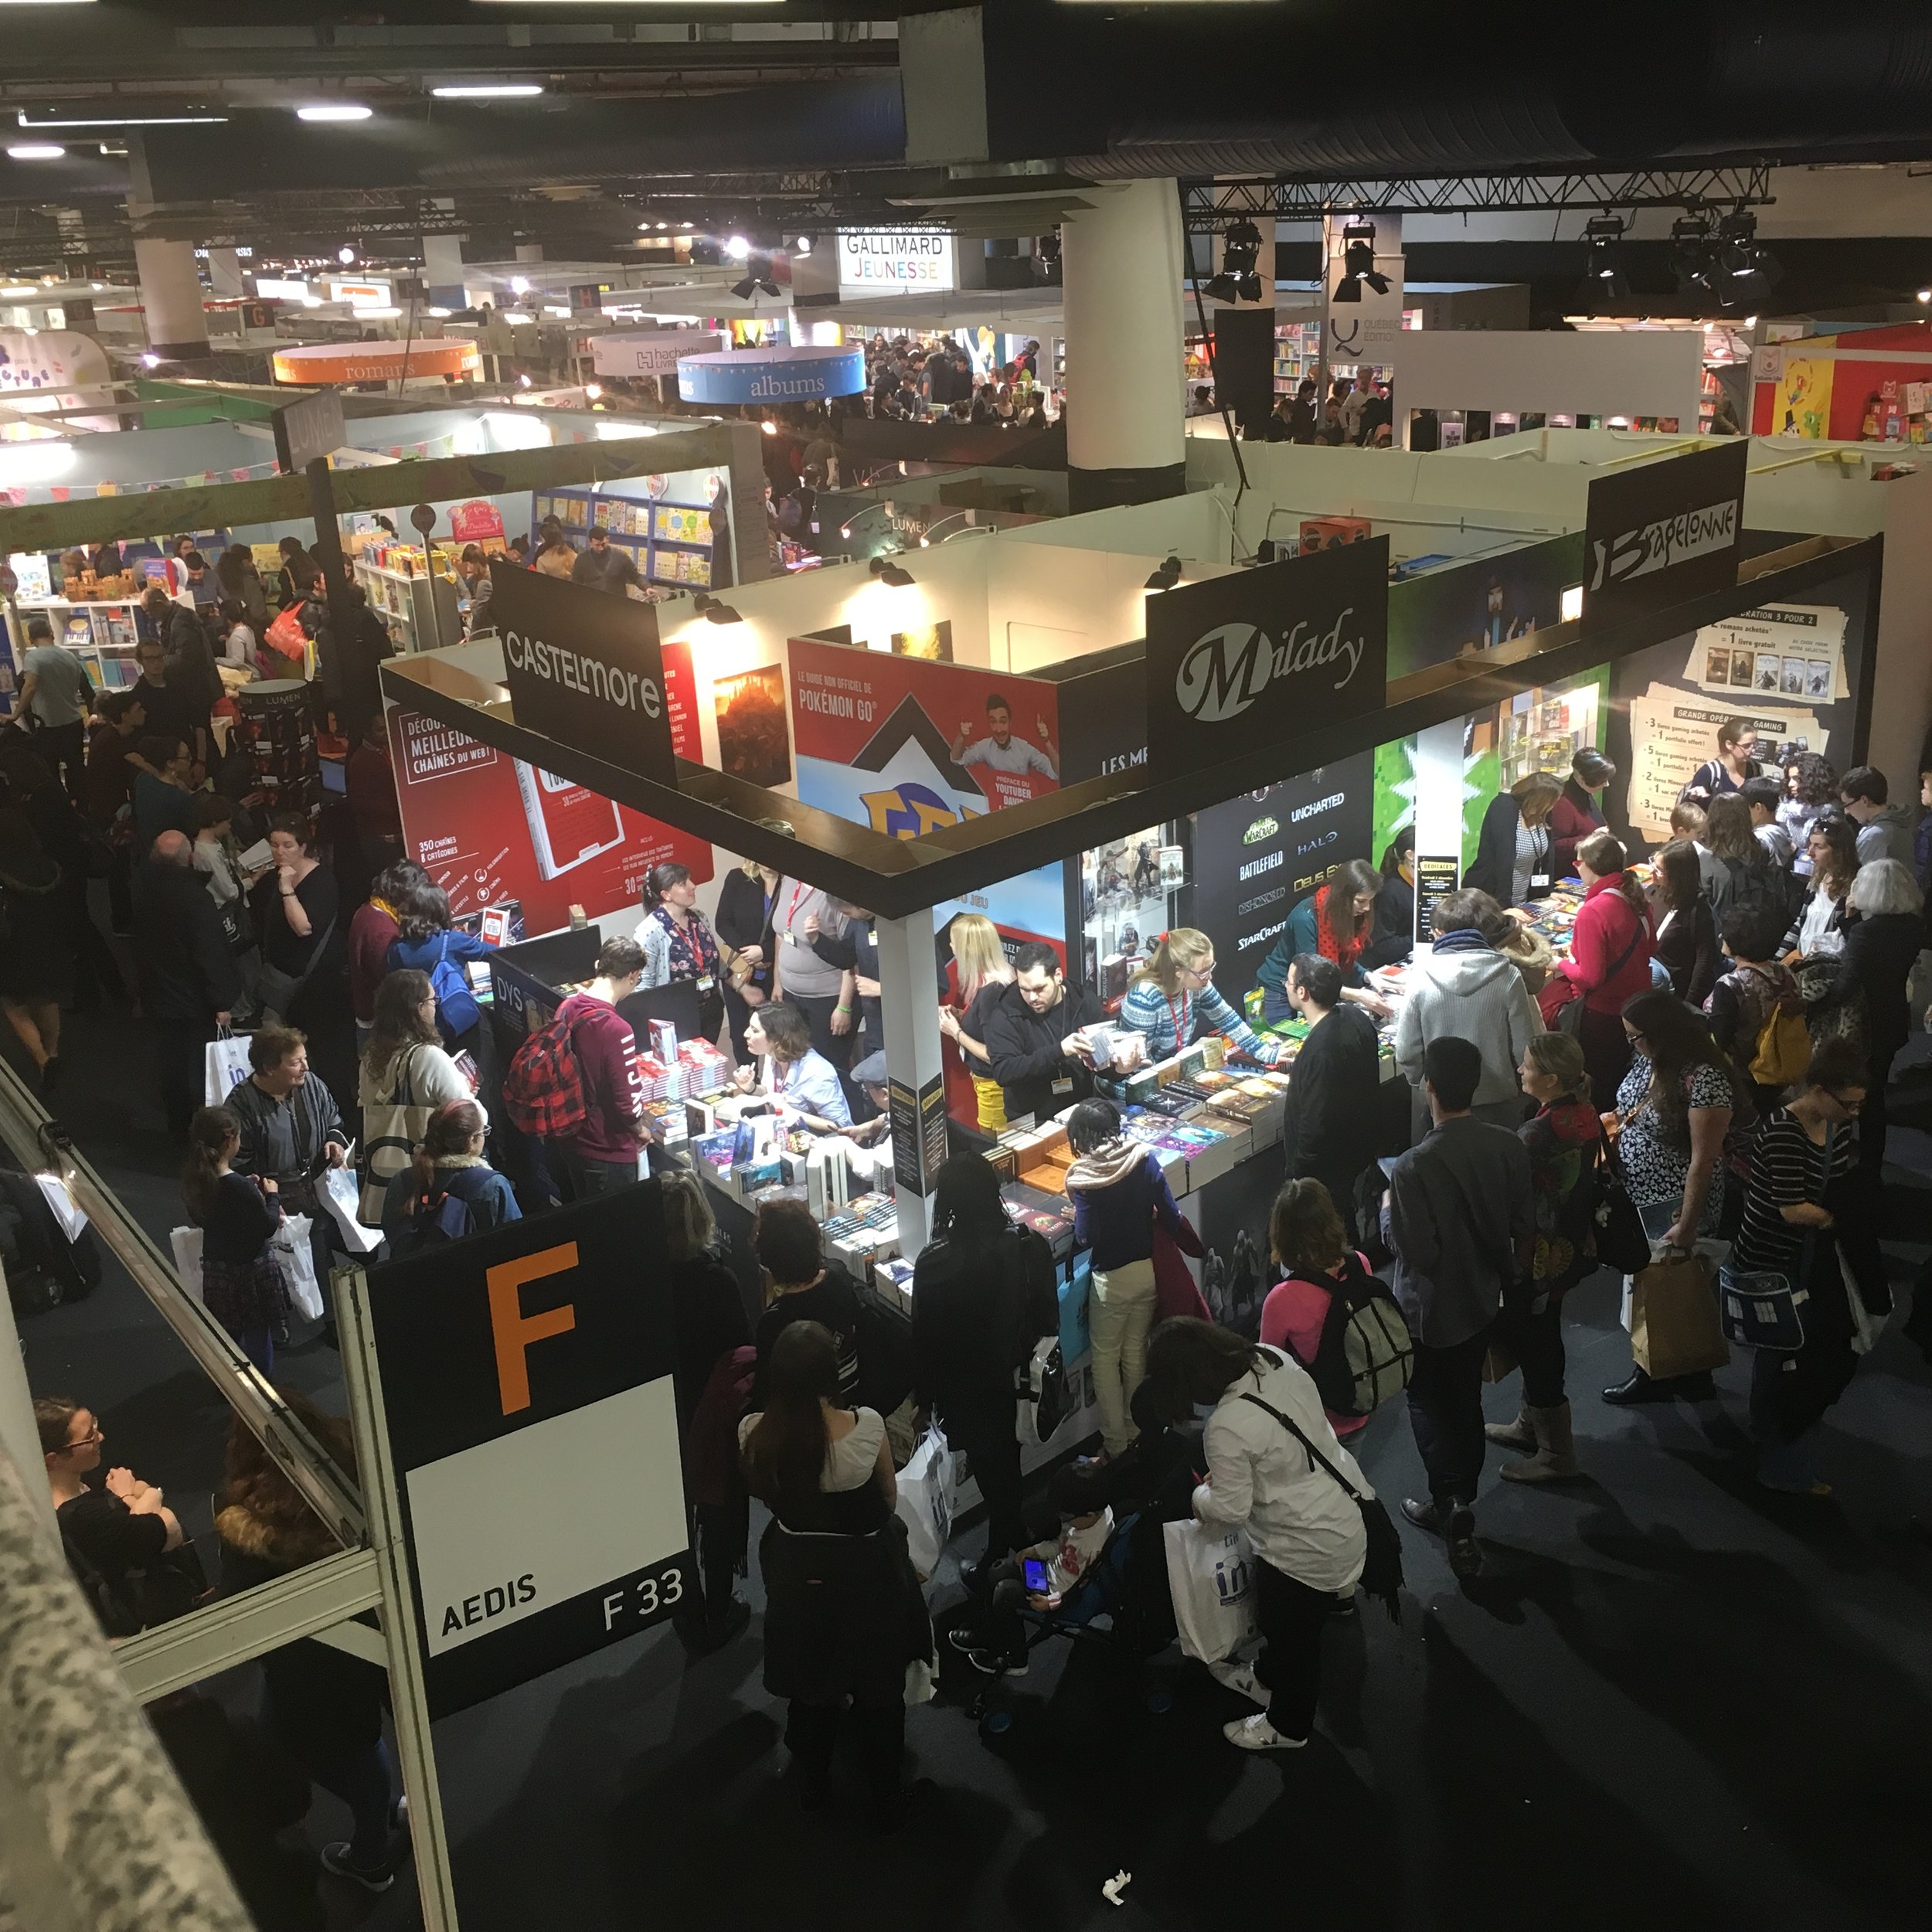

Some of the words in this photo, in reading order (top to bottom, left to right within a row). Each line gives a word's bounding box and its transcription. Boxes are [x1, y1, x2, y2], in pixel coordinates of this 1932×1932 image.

[847, 235, 943, 256] GALLIMARD
[855, 258, 938, 279] JEUNESSE
[252, 307, 265, 326] G
[345, 362, 416, 379] romans
[750, 376, 825, 397] albums
[1784, 614, 1804, 624] POUR
[1808, 616, 1813, 624] 2
[1730, 632, 1736, 645] 1
[1738, 638, 1752, 646] livre
[1753, 641, 1776, 649] gratuit
[1175, 607, 1364, 722] Milady
[798, 671, 805, 682] LE
[798, 688, 854, 719] POKÉMON
[408, 717, 446, 736] DÉCOU
[1649, 718, 1655, 727] 3
[1677, 709, 1707, 720] GRANDE
[1709, 713, 1735, 723] OPÉR
[1753, 719, 1783, 731] GAMING
[411, 730, 479, 758] MEILLEUR
[1648, 745, 1654, 755] 5
[413, 752, 456, 774] CHAÎNES
[457, 751, 468, 764] DU
[1646, 771, 1652, 781] 2
[1668, 778, 1685, 787] Minecr
[995, 782, 1032, 799] YOUTUBER
[1291, 792, 1345, 822] UNCHARTED
[1644, 799, 1650, 808] 3
[419, 839, 434, 852] 350
[1298, 831, 1338, 855] HALO
[420, 853, 426, 863] 8
[427, 846, 458, 861] CATÉGORIES
[1240, 850, 1283, 881] BATTLEFIELD
[624, 876, 636, 895] 30
[1294, 871, 1325, 893] DEUS
[970, 895, 988, 910] JEU
[1237, 920, 1287, 951] STARCRAFT
[497, 976, 523, 1012] DYS
[485, 1241, 579, 1417] F
[440, 1573, 536, 1638] AEDIS
[602, 1591, 624, 1631] F
[635, 1567, 684, 1616] 33
